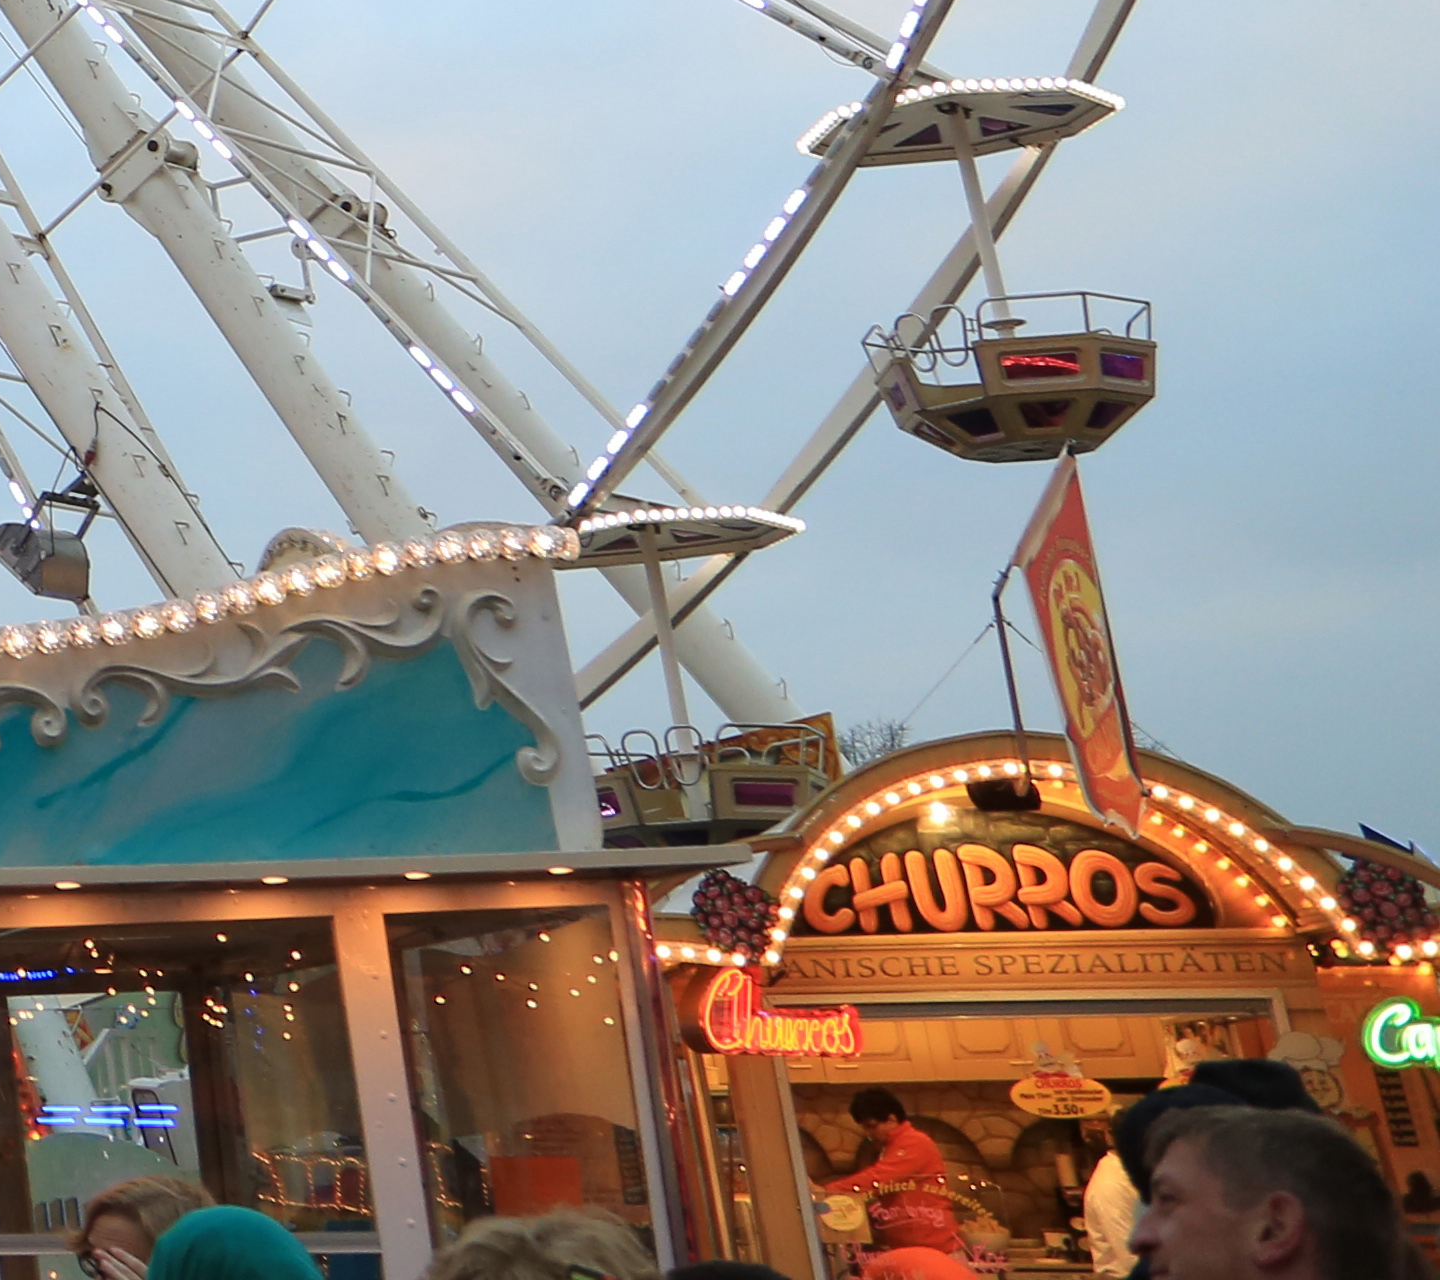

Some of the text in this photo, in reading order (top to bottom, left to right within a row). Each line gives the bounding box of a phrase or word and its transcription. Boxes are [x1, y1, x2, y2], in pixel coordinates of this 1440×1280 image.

[803, 842, 1197, 934] CHURROS
[765, 947, 1291, 981] ANISCHE SPEZIALITÄTEN
[705, 968, 855, 1055] Churros
[1370, 1002, 1440, 1070] Ca
